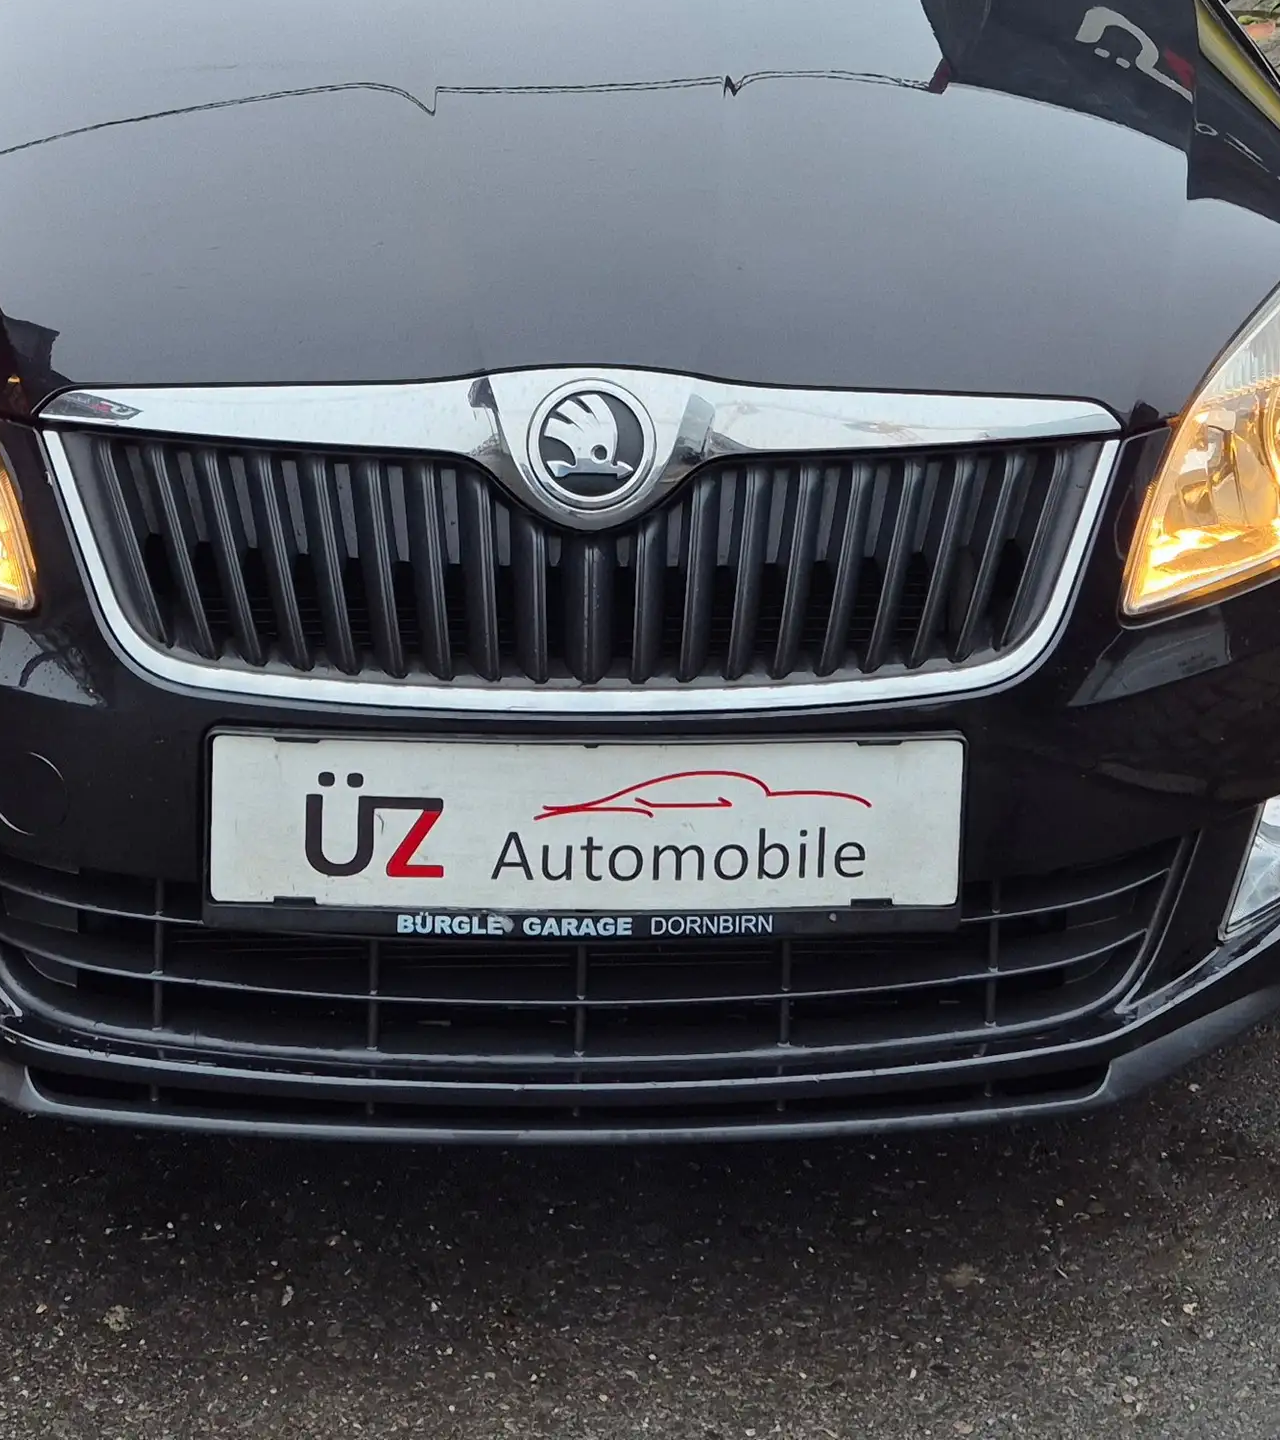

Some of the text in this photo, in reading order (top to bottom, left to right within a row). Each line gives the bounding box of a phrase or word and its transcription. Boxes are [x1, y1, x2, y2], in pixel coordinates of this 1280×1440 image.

[305, 771, 444, 878] ÜZ
[491, 827, 867, 882] Automobile
[396, 911, 774, 937] BÜRGLE GARAGE DORNBIRN
